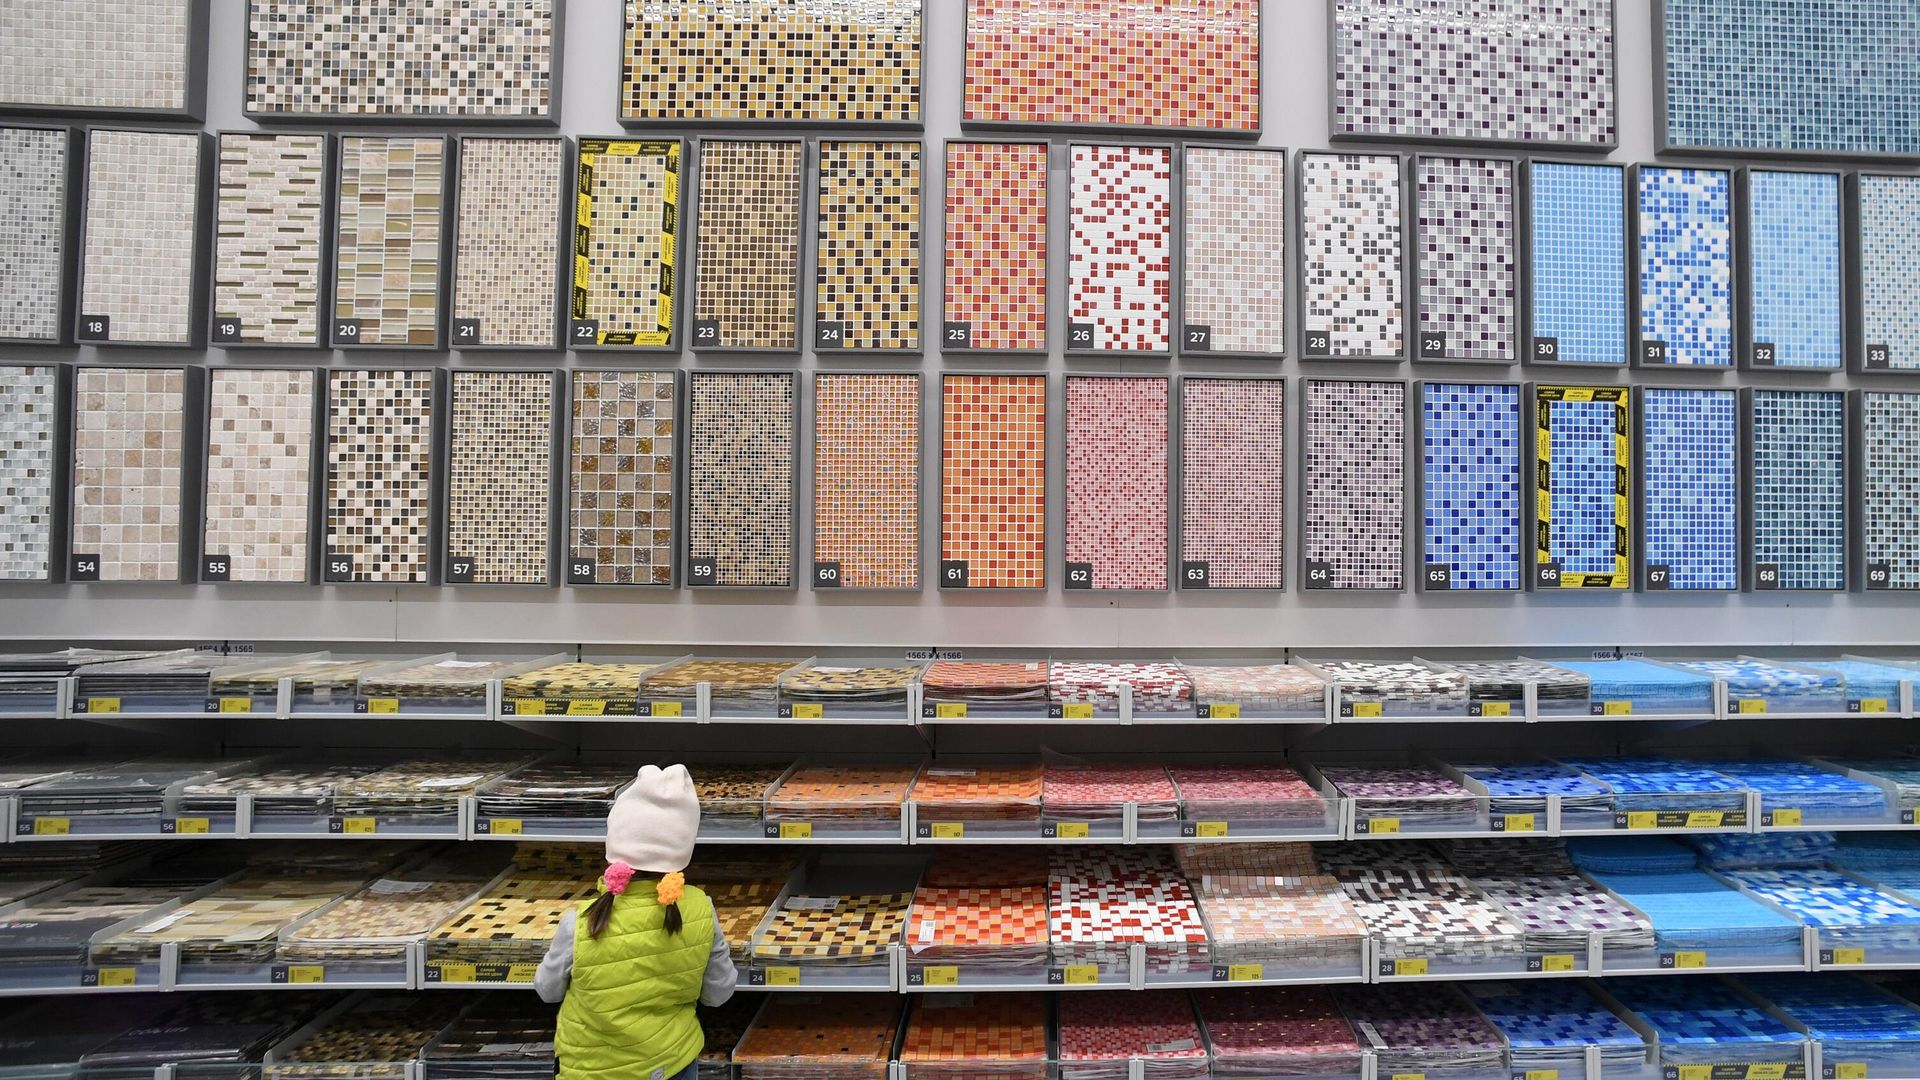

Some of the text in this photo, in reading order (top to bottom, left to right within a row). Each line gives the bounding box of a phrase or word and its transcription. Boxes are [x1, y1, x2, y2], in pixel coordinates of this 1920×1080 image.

[88, 322, 102, 332] 18
[221, 324, 235, 335] 19
[339, 325, 356, 336] 20
[460, 326, 474, 336] 21
[577, 326, 593, 337] 22
[698, 327, 714, 338] 23
[822, 330, 838, 340] 24
[949, 329, 965, 340] 25
[1073, 330, 1090, 341] 26
[1190, 332, 1206, 342] 27
[1310, 337, 1326, 348] 28
[1426, 340, 1441, 350] 29
[1538, 344, 1554, 354] 30
[1648, 347, 1660, 357] 31
[1756, 349, 1770, 360] 32
[1871, 350, 1885, 361] 33
[78, 562, 95, 572] 54
[209, 562, 226, 573] 55
[332, 562, 348, 573] 56
[454, 564, 469, 574] 57
[574, 564, 590, 575] 58
[694, 565, 711, 576] 59
[820, 569, 836, 580] 60
[948, 568, 961, 579] 61
[1071, 570, 1087, 581] 62
[1188, 569, 1204, 580] 63
[1310, 569, 1326, 580] 64
[1430, 571, 1446, 581] 65
[1541, 569, 1556, 580] 66
[1651, 571, 1666, 582] 67
[1760, 570, 1775, 581] 68
[1870, 570, 1885, 581] 69
